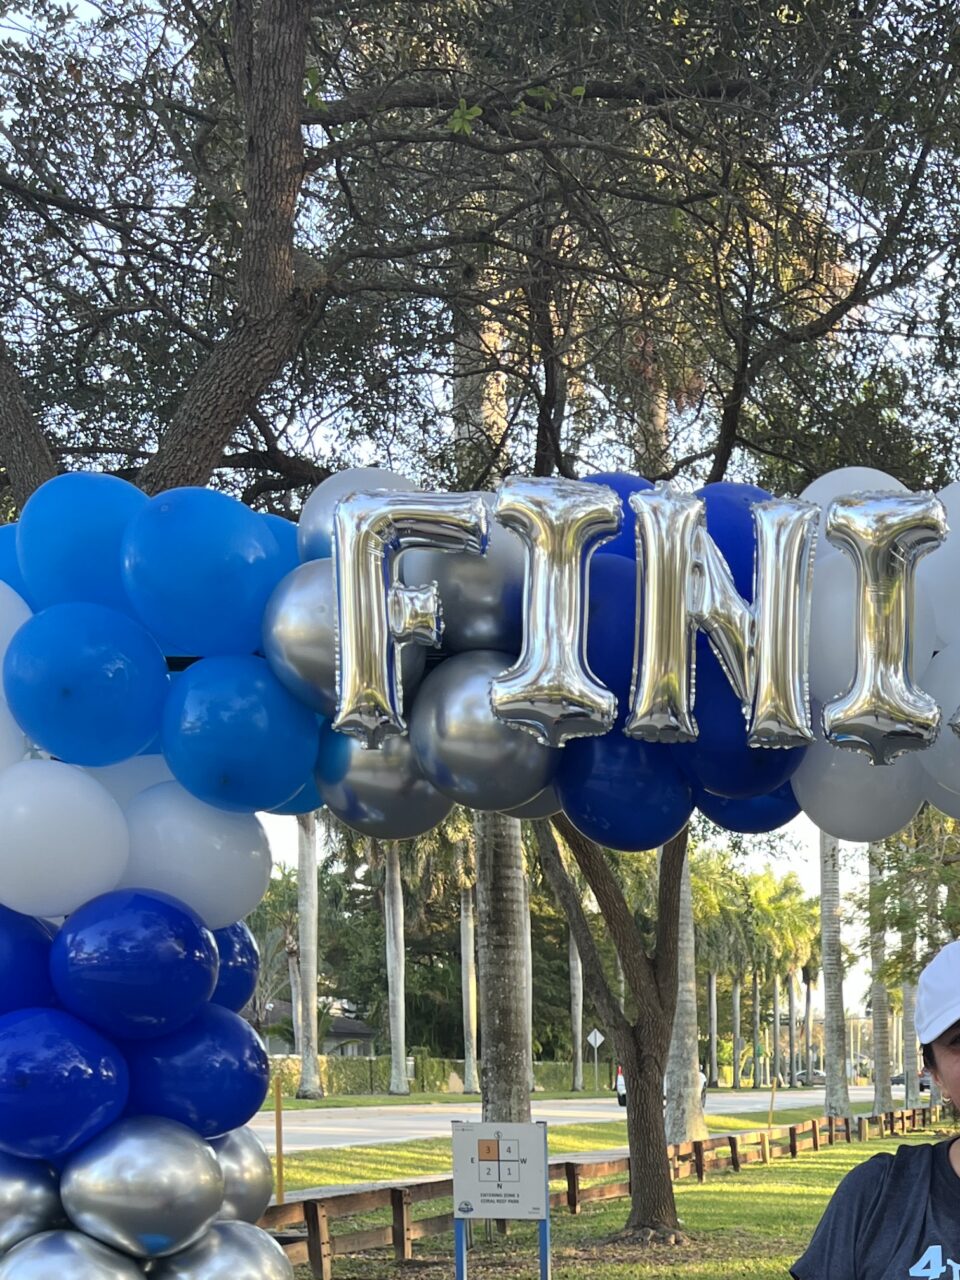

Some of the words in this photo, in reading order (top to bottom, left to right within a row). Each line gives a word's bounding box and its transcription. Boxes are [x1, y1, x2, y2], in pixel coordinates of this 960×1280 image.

[485, 1146, 491, 1154] 3
[506, 1146, 512, 1154] 4
[486, 1167, 492, 1176] 2
